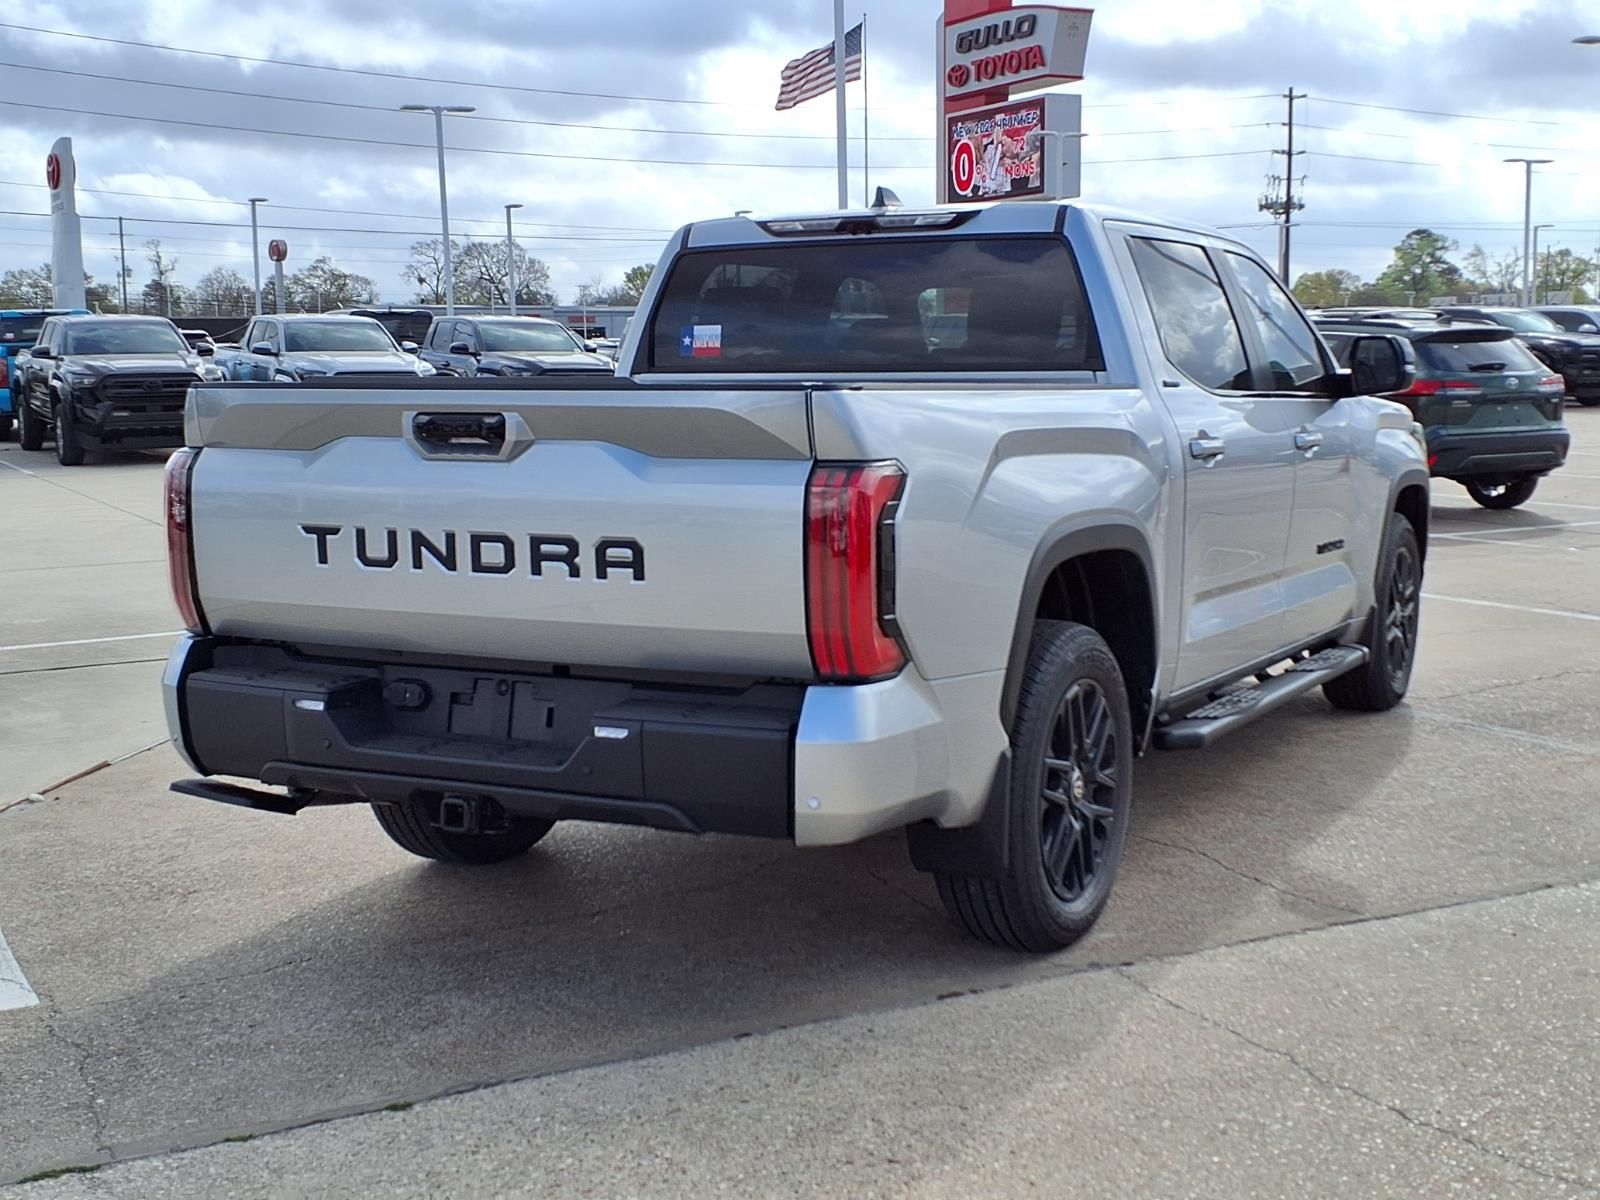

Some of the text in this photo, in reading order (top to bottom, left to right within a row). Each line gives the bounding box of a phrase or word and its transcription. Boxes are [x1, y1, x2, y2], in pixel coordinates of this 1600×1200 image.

[956, 14, 1036, 54] GULLO
[971, 44, 1045, 82] TOYOTA
[297, 523, 646, 584] TUNDRA
